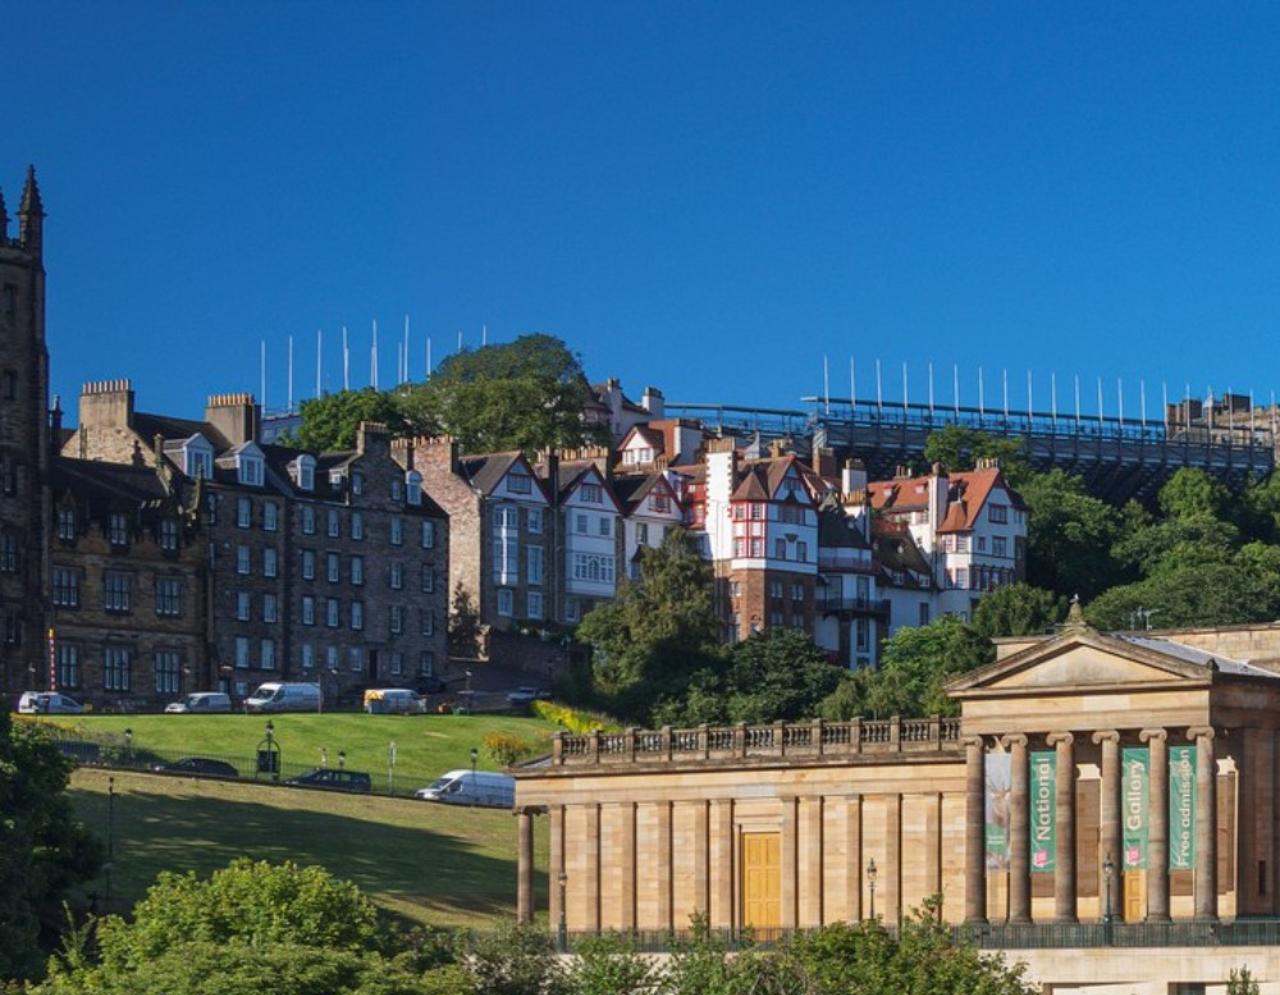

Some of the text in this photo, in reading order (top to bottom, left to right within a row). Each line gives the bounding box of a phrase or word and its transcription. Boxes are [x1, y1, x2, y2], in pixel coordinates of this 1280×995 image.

[1036, 757, 1052, 841] National
[1126, 759, 1145, 831] Gallery
[1177, 749, 1192, 866] Free admission
